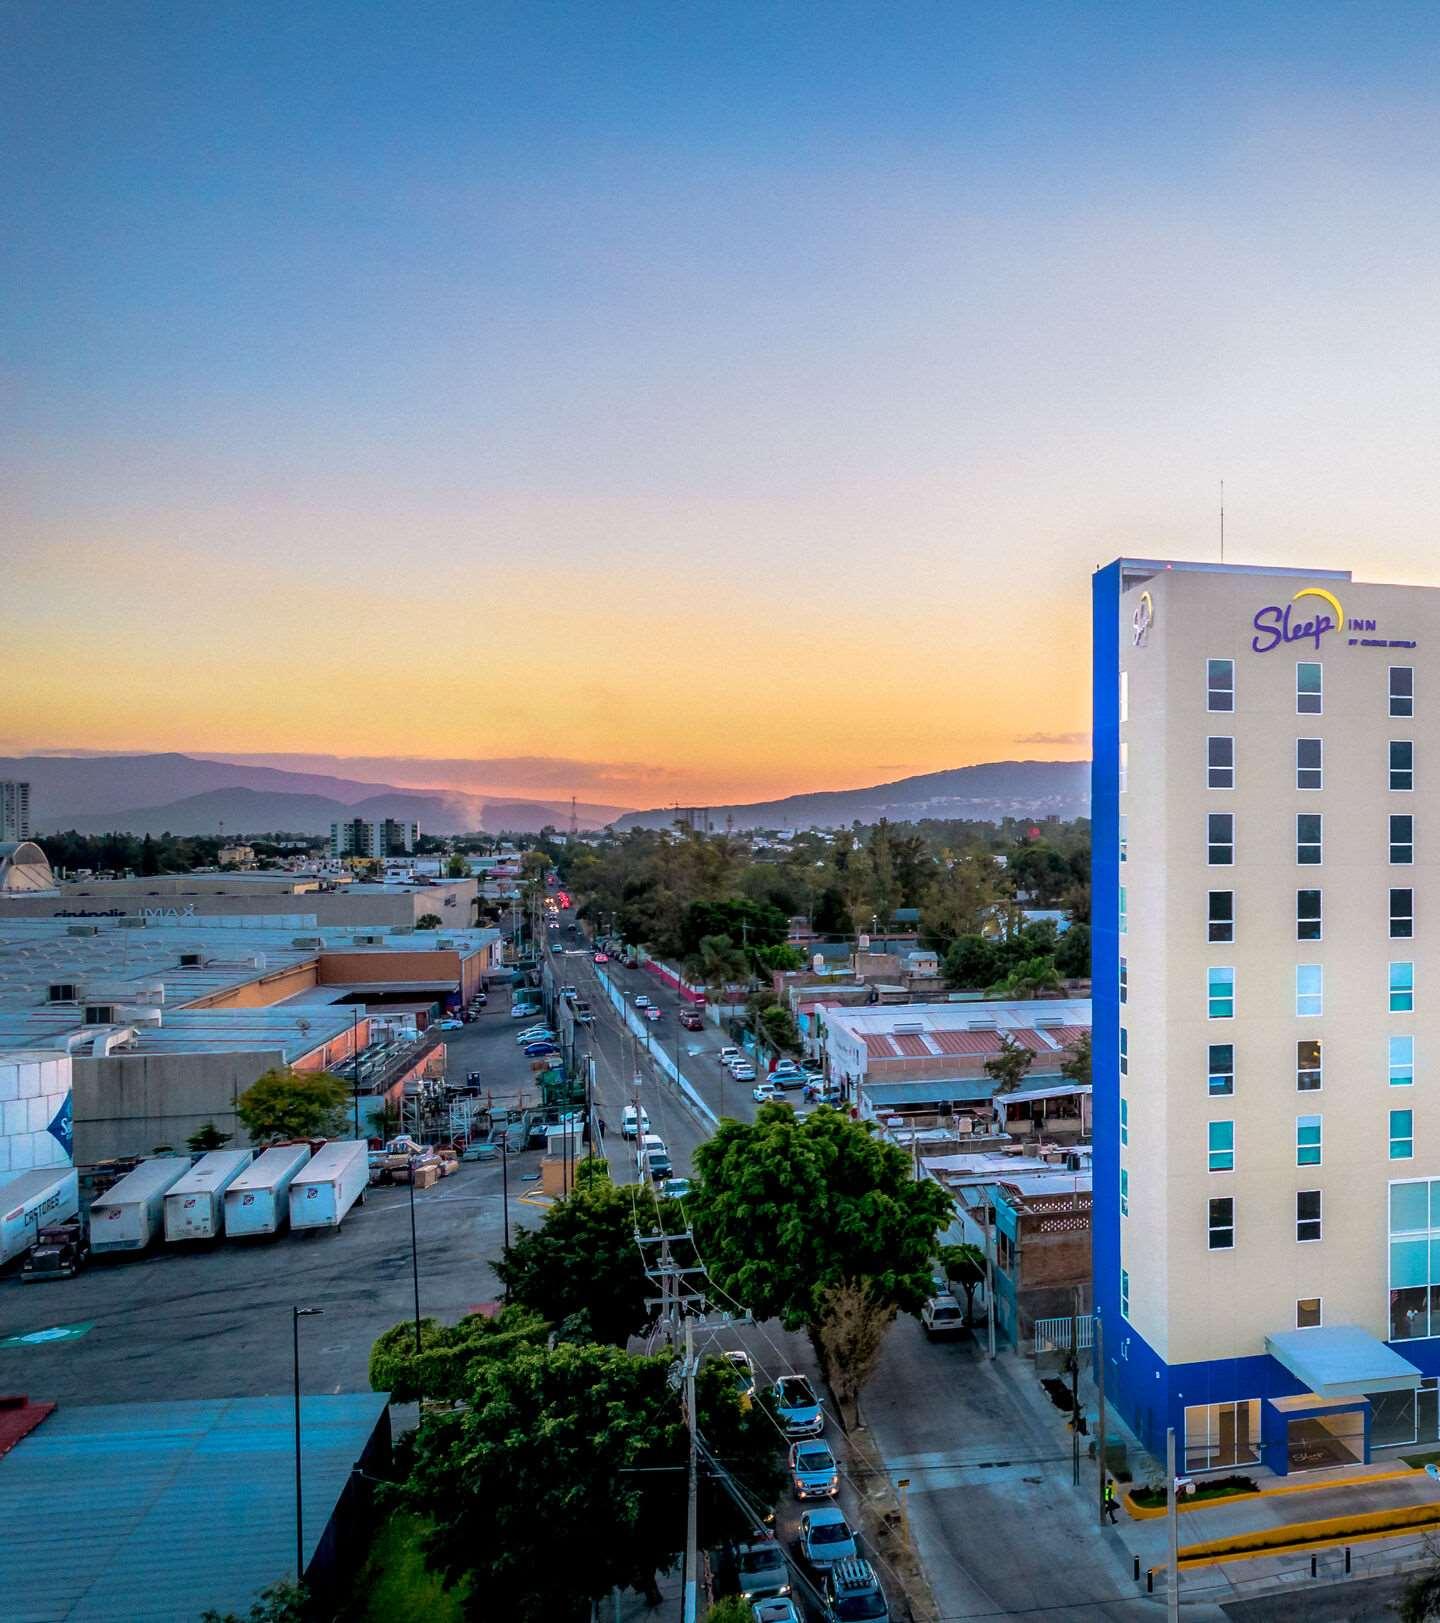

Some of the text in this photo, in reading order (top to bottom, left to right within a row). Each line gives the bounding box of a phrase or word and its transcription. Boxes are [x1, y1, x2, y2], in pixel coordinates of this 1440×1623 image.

[1252, 604, 1376, 653] Sleep INN
[137, 905, 196, 920] IMAX
